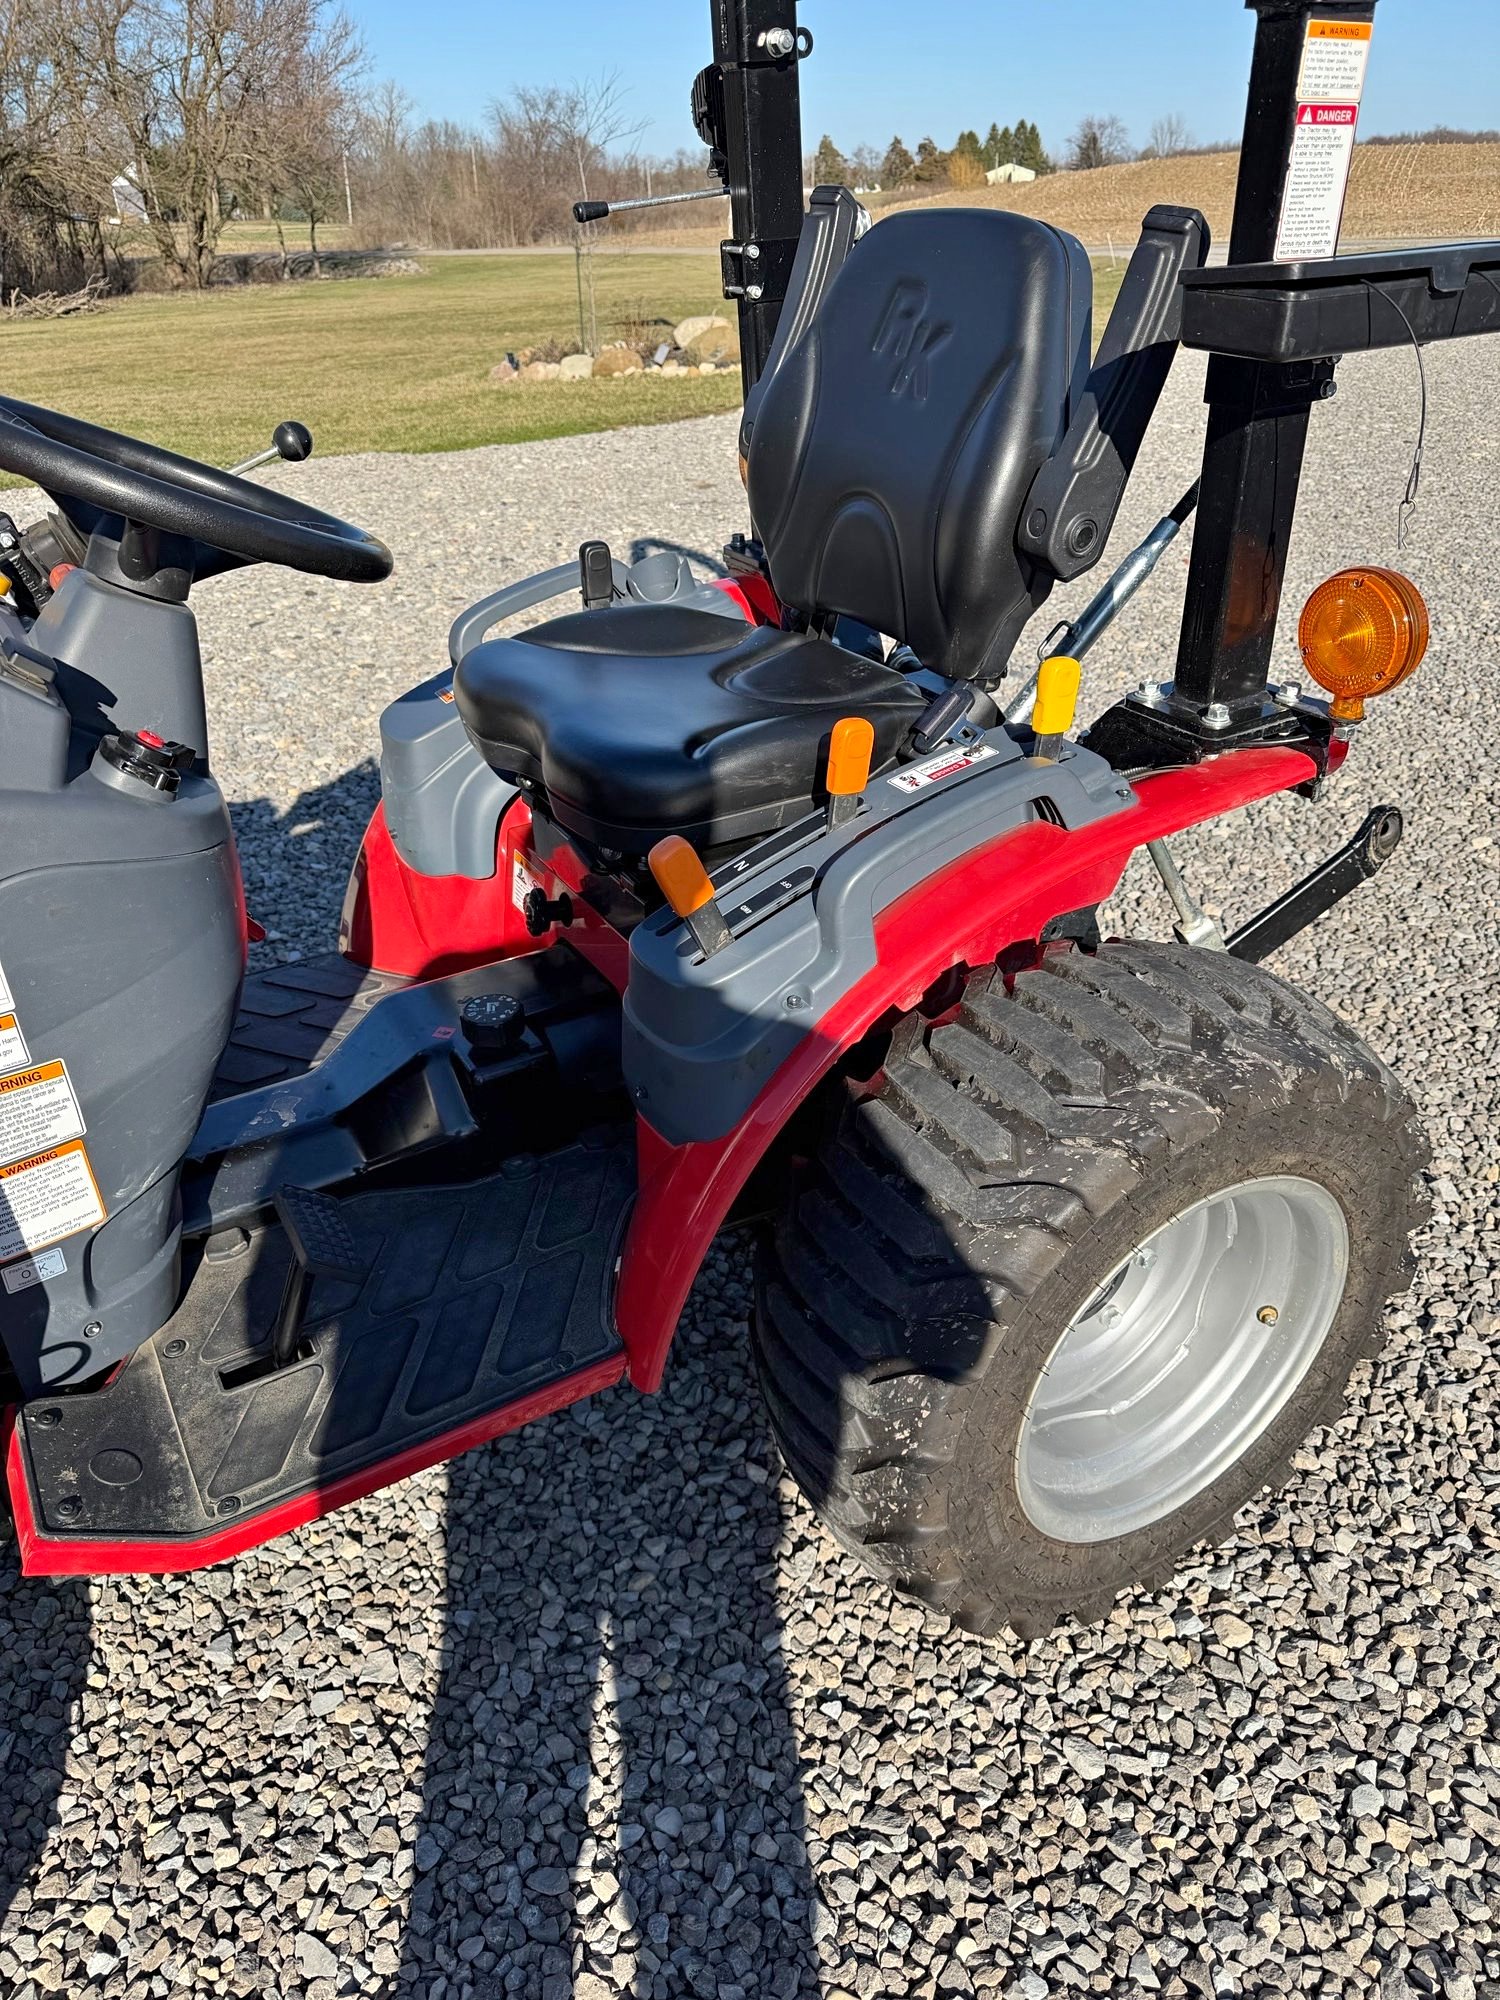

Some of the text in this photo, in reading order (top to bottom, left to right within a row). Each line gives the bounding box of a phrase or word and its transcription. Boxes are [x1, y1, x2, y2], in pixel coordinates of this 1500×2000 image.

[1329, 27, 1360, 36] WARNING
[1316, 110, 1352, 122] DANGER
[930, 764, 960, 779] DANGER
[733, 860, 750, 872] N
[780, 880, 793, 889] OFF
[740, 904, 753, 914] 4WD
[2, 1036, 18, 1044] Harm
[0, 1072, 42, 1092] RNING
[5, 1150, 58, 1176] WARNING
[53, 1154, 80, 1168] operators
[8, 1181, 26, 1190] safety
[44, 1166, 64, 1176] switch
[17, 1182, 38, 1192] engine
[52, 1172, 66, 1180] start
[14, 1194, 38, 1206] connect
[48, 1184, 62, 1194] short
[65, 1177, 83, 1187] across
[17, 1207, 40, 1218] booster
[41, 1199, 60, 1209] cables
[70, 1186, 89, 1197] shown
[30, 1196, 49, 1207] starter
[30, 1210, 46, 1219] decal
[48, 1204, 60, 1212] and
[61, 1192, 88, 1206] operators
[0, 1240, 24, 1251] Starting
[34, 1230, 47, 1239] gear
[50, 1220, 72, 1232] causing
[74, 1209, 98, 1222] runaway
[42, 1230, 64, 1240] serious
[22, 1270, 31, 1278] O
[38, 1262, 48, 1272] K
